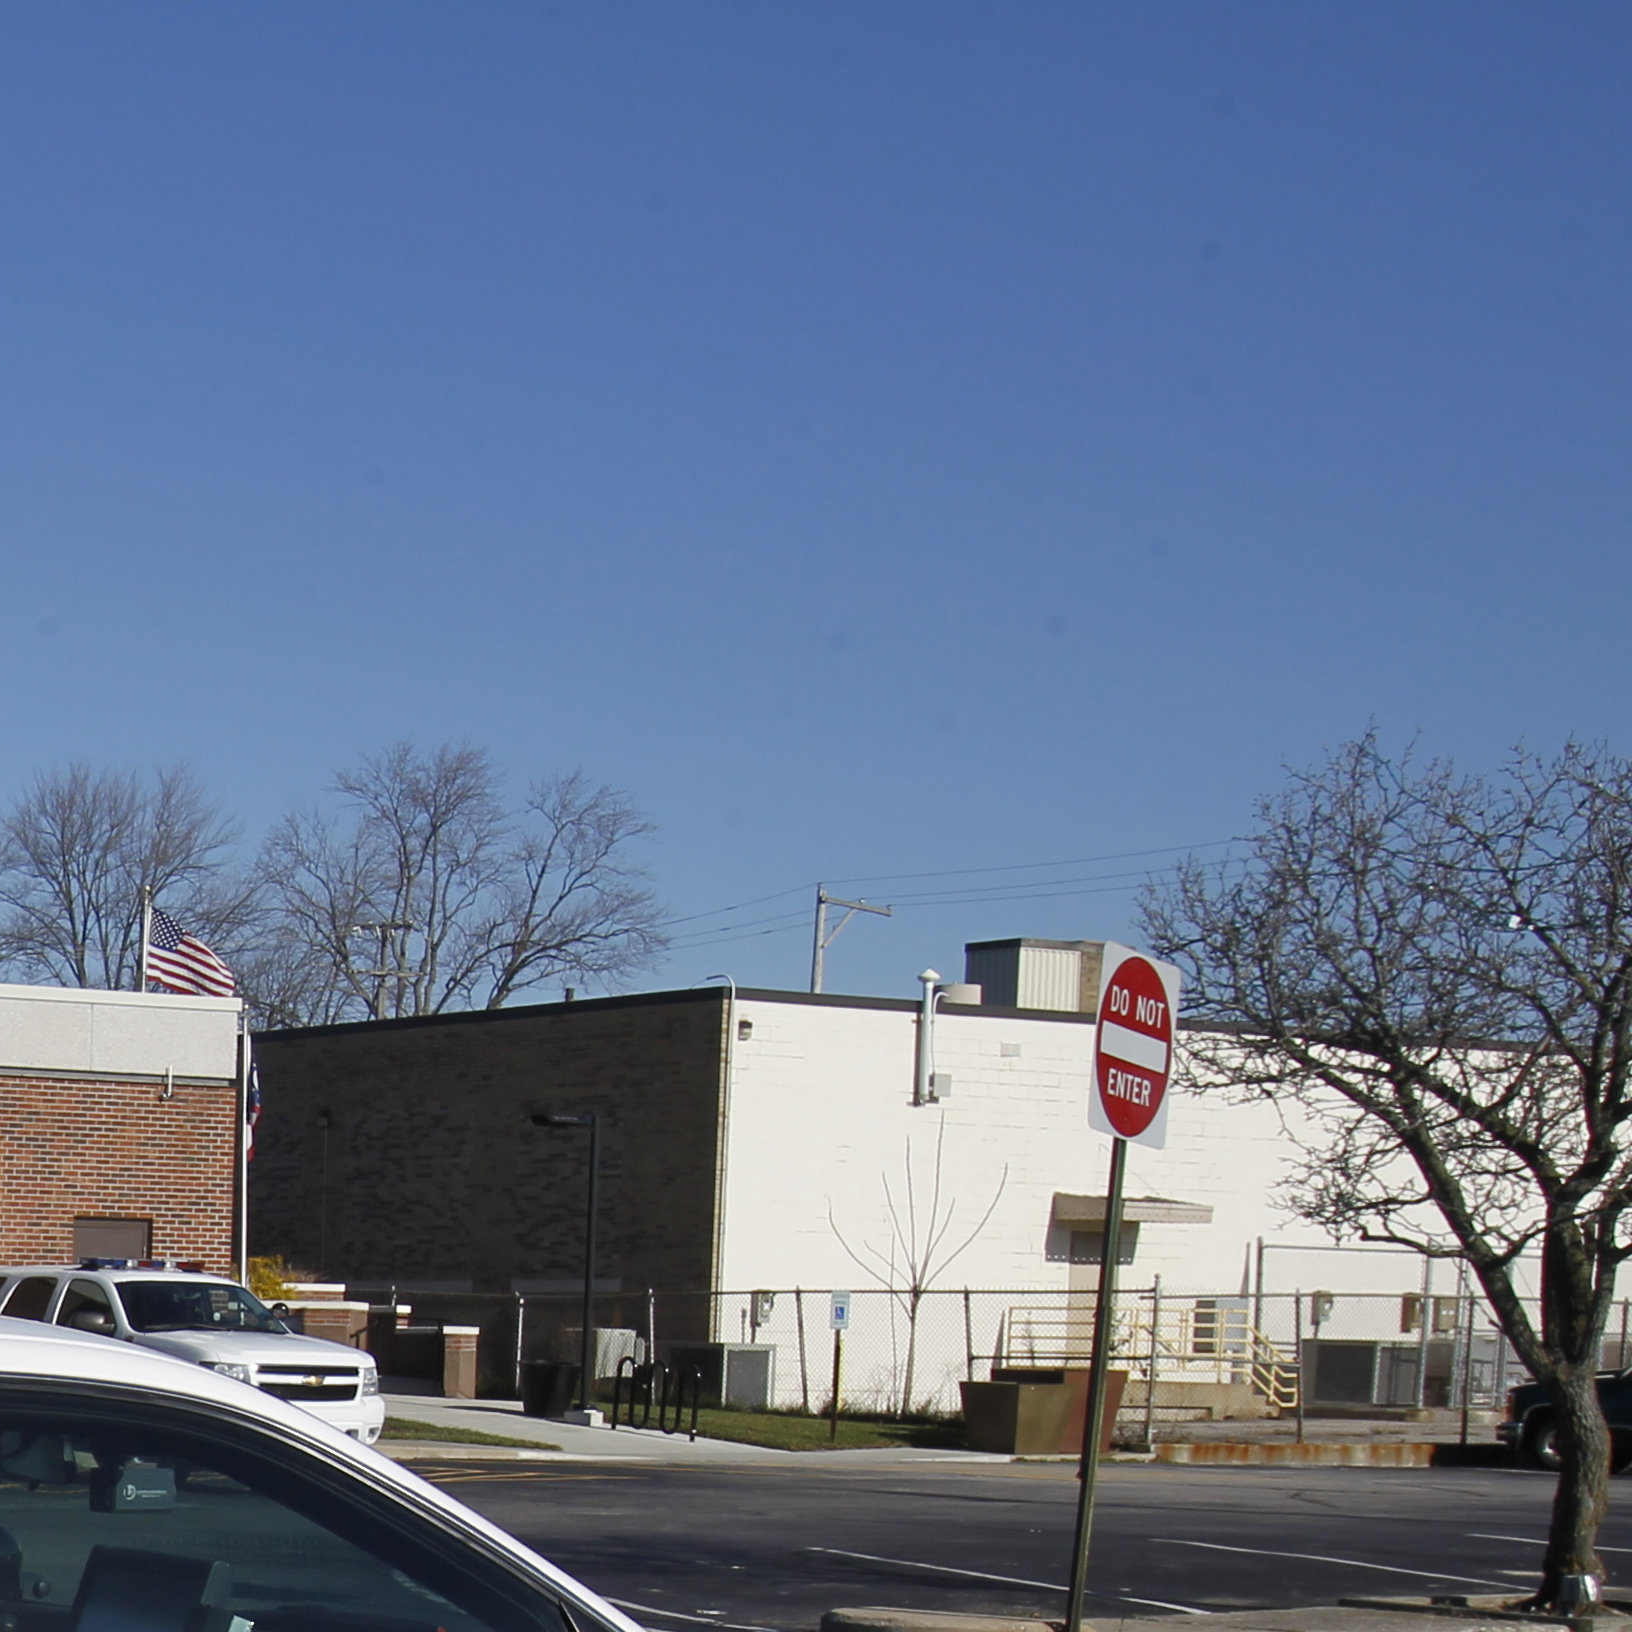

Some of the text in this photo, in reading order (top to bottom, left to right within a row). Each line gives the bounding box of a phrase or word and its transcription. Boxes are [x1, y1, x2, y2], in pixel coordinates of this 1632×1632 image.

[1110, 984, 1165, 1028] DO NOT
[1107, 1067, 1152, 1107] ENTER
